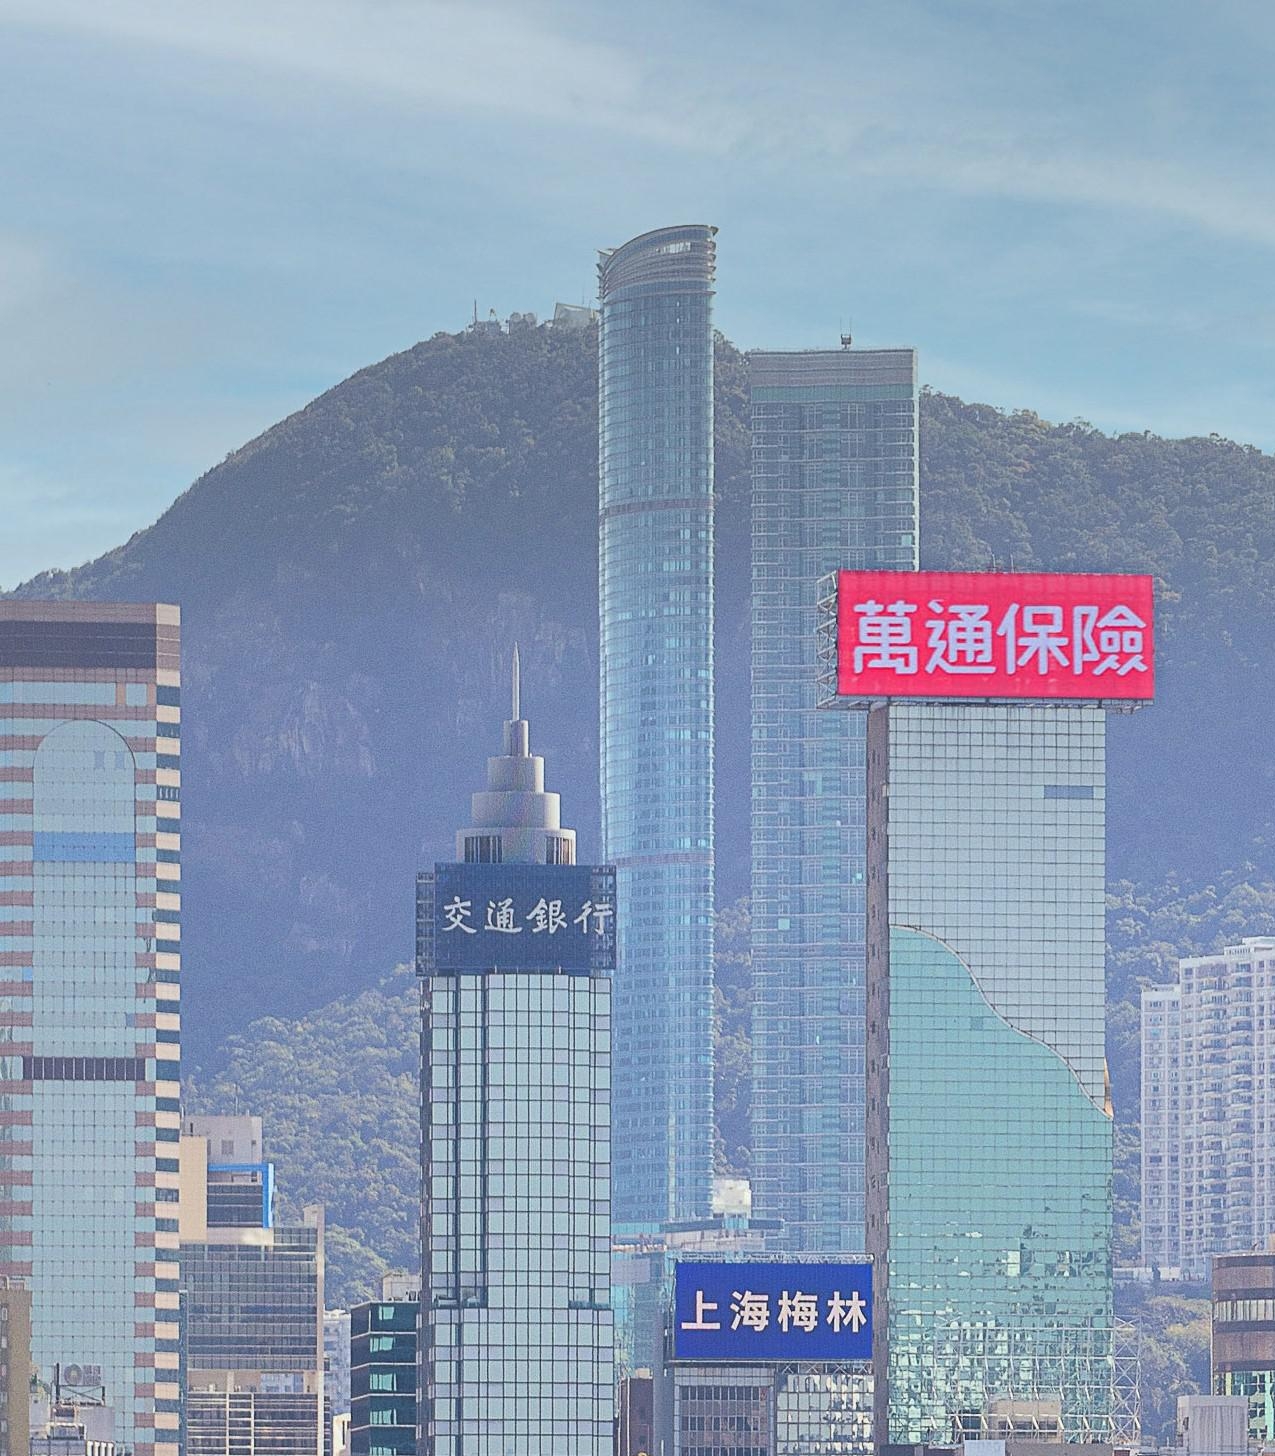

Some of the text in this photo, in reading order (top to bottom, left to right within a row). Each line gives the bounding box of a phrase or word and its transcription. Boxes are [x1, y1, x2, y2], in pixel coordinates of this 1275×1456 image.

[853, 600, 1149, 676] 萬通保險
[442, 896, 614, 935] 交通銀行
[681, 1290, 867, 1333] 上海梅林
